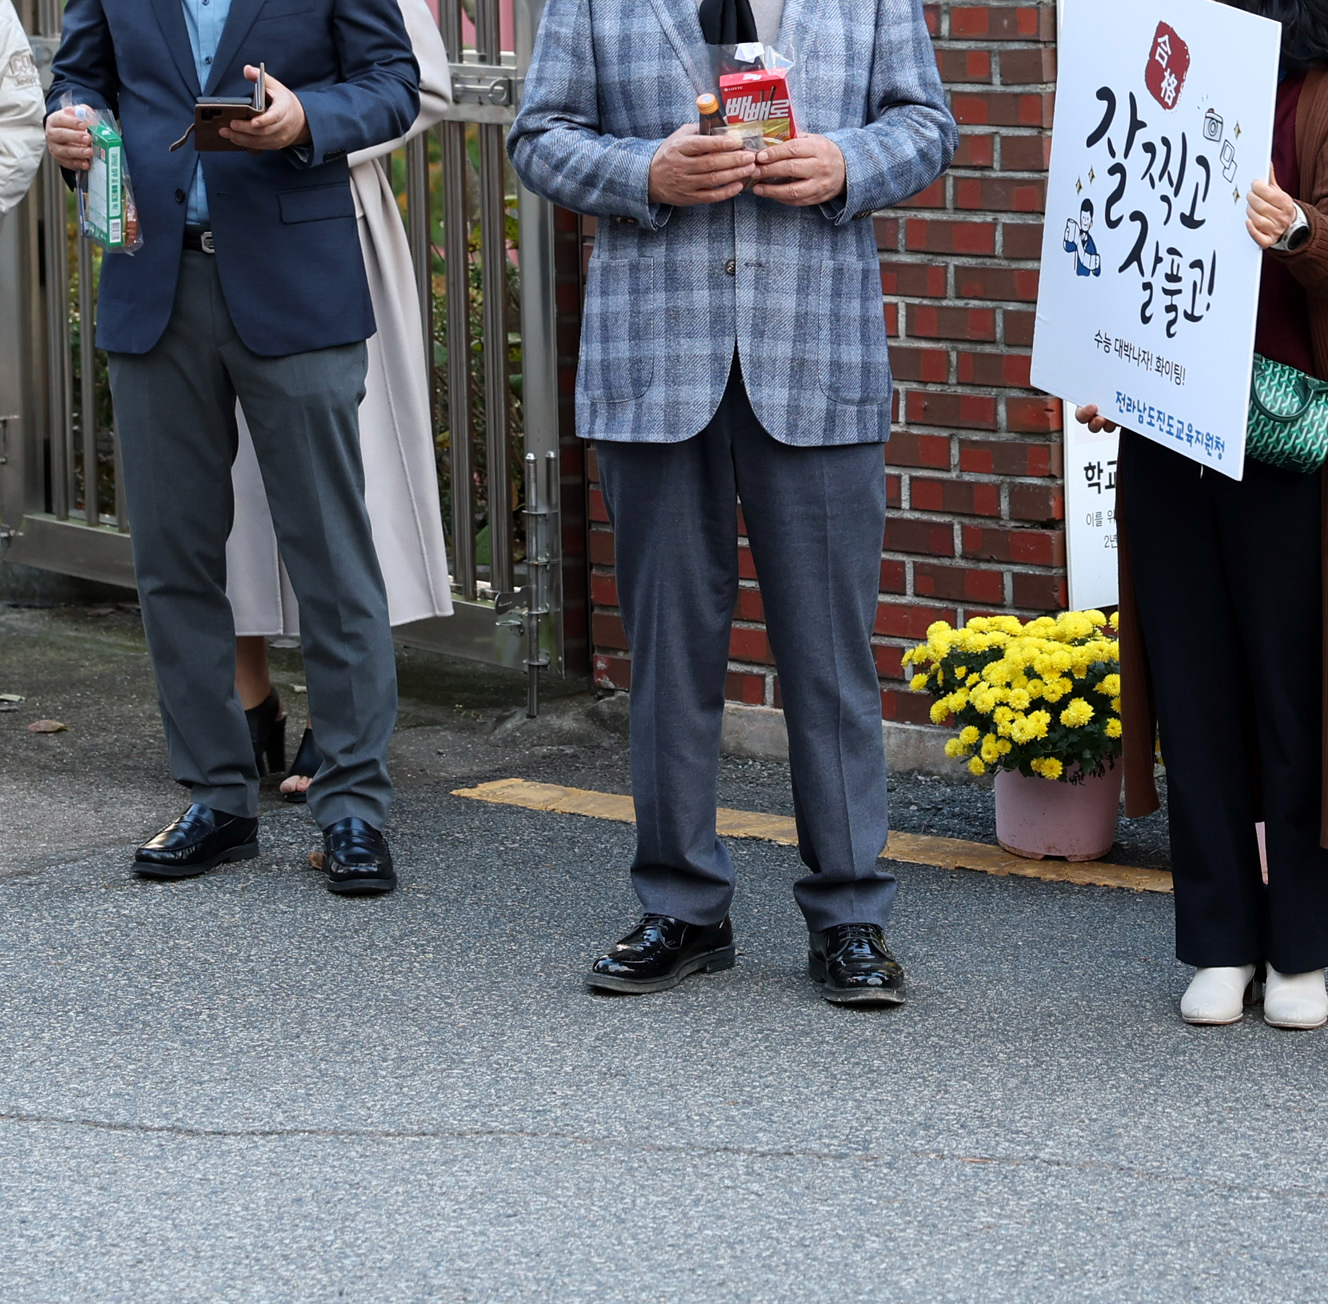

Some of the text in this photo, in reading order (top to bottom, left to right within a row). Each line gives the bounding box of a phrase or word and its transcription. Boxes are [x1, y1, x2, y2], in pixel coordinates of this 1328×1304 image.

[1155, 34, 1178, 107] 合格
[725, 95, 790, 123] 빼빼로
[1093, 329, 1186, 387] 수능 대박나자! 화이팅!
[1115, 389, 1226, 461] 전라남도진도교육지원청
[1085, 511, 1104, 528] 이를
